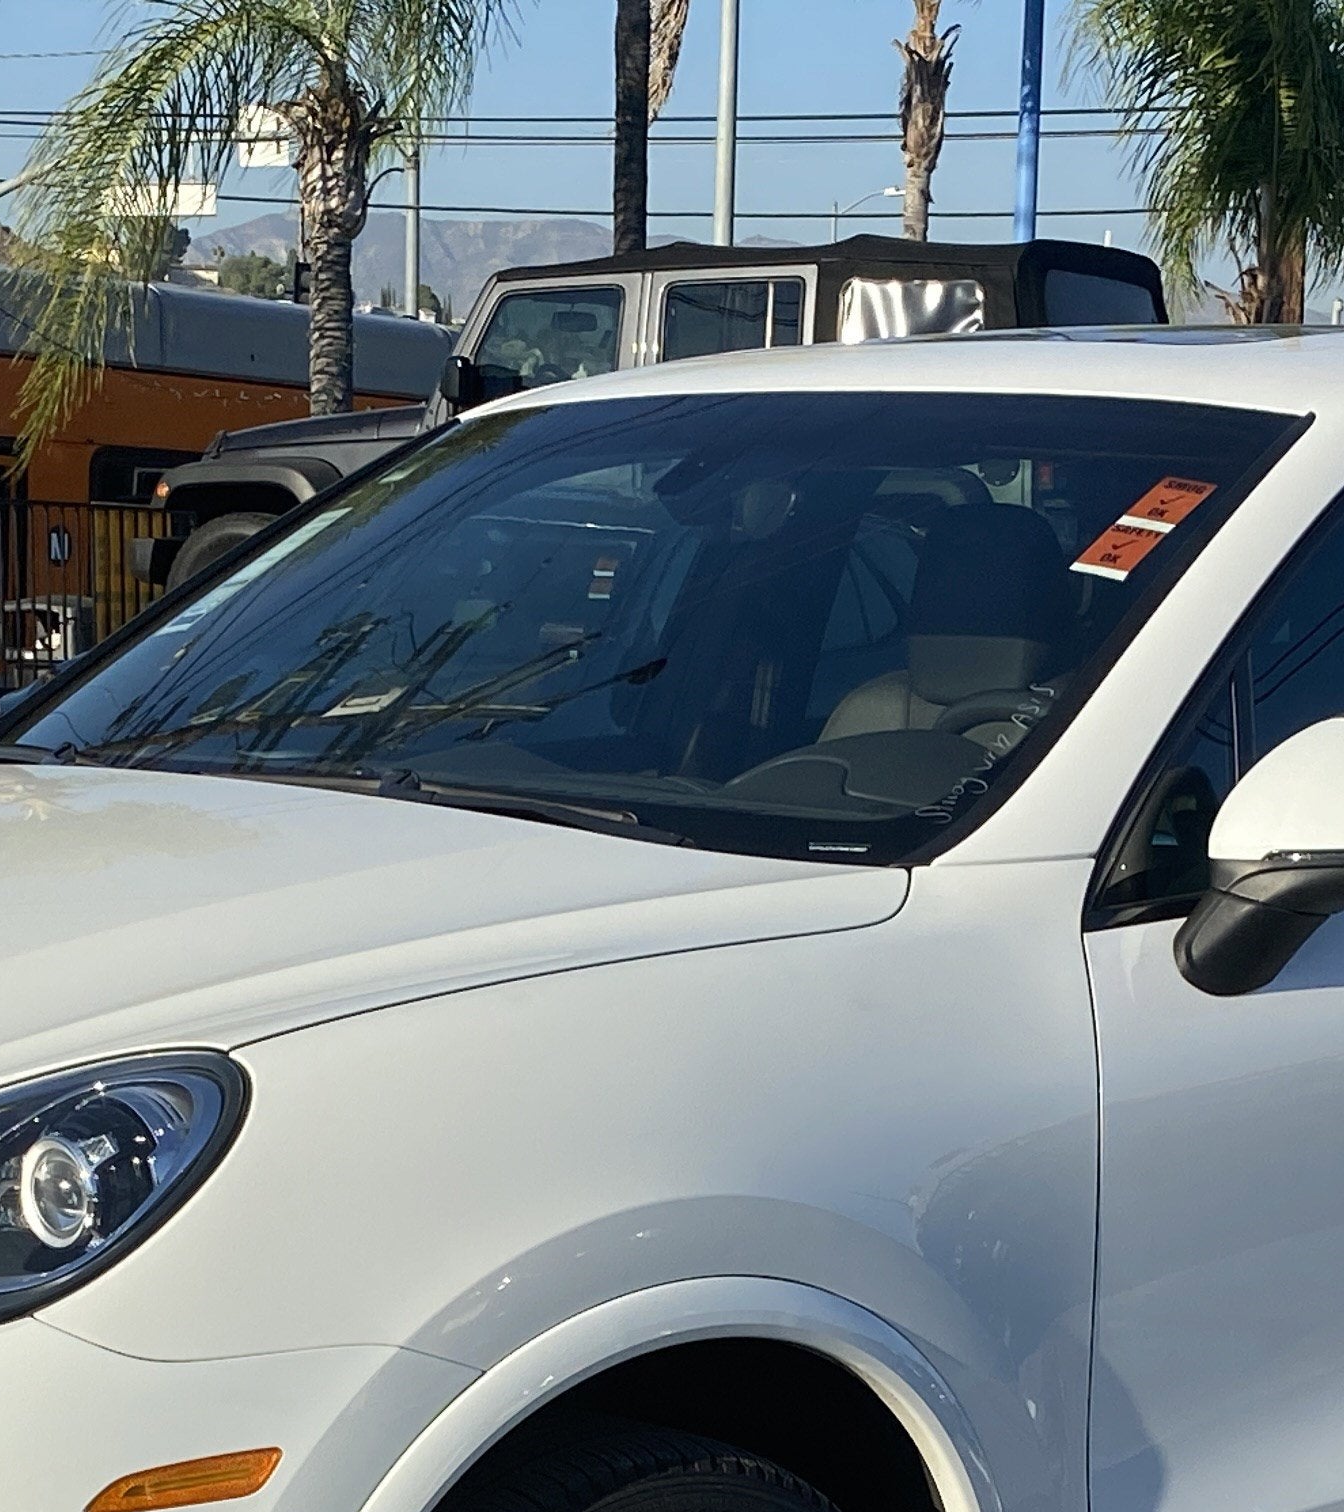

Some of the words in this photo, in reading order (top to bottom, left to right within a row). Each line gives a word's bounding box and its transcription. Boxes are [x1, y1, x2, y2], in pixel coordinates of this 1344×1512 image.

[1163, 480, 1207, 494] SMOG
[1147, 507, 1170, 518] OK
[1099, 553, 1122, 564] OK
